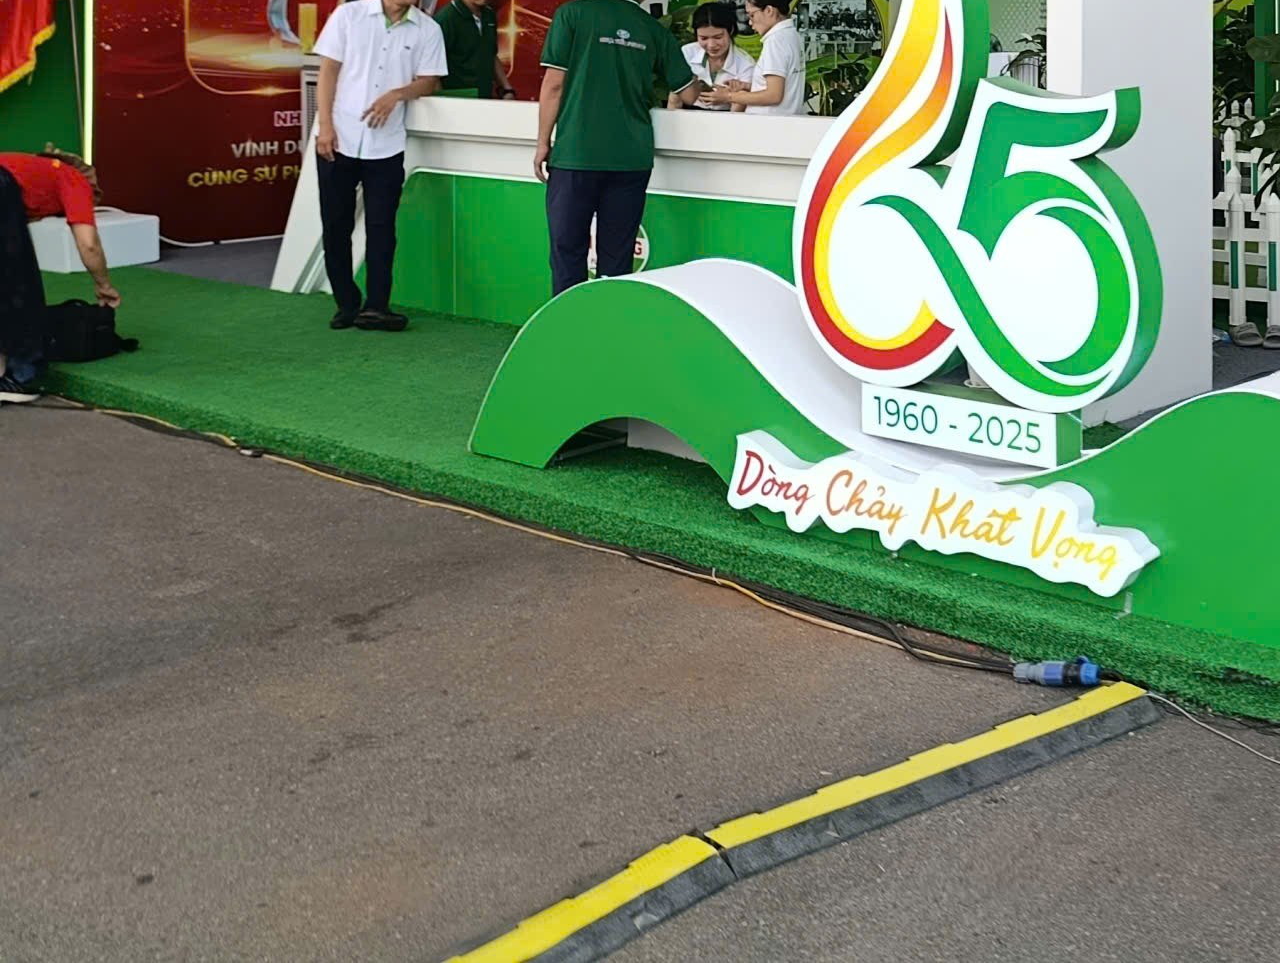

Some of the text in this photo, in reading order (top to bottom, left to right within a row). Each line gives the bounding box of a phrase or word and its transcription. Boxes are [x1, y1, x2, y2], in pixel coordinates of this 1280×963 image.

[187, 167, 249, 187] CÙNG
[253, 164, 279, 185] SỰ
[873, 396, 939, 435] 1960
[968, 412, 1042, 454] 2025
[736, 450, 1124, 580] Dòng Chảy Khát Vọng
